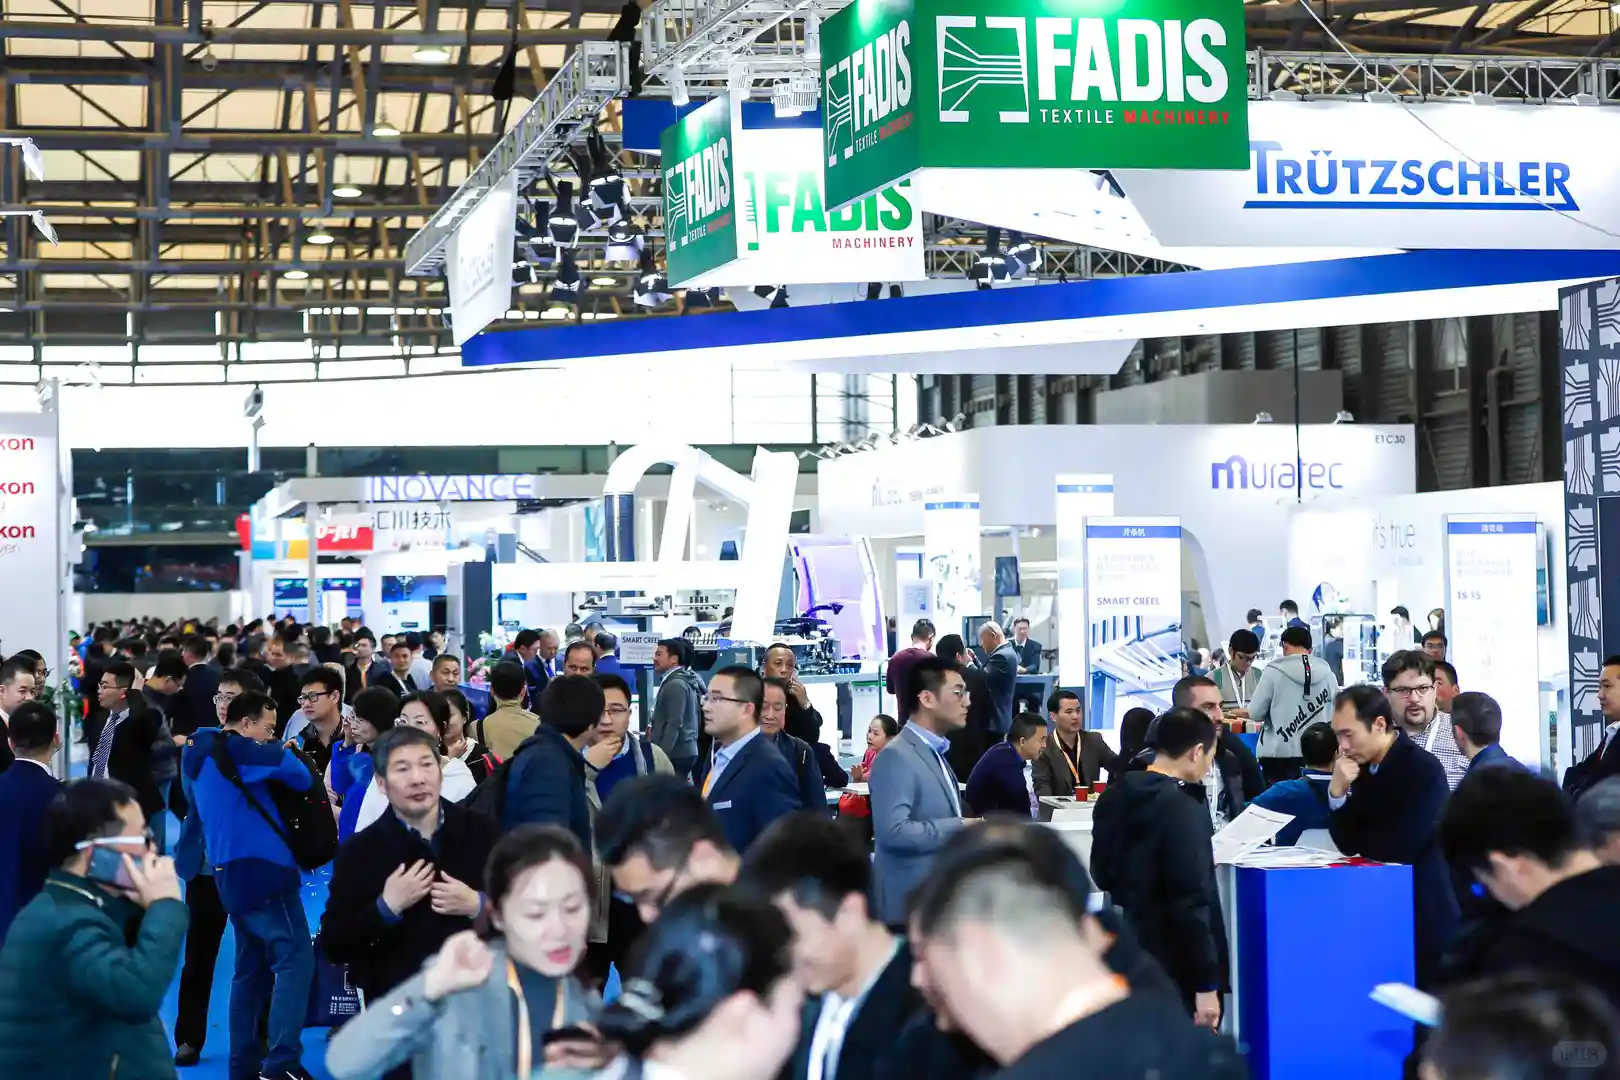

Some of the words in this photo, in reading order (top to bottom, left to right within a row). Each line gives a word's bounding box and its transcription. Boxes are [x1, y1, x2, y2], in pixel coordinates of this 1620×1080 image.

[1035, 17, 1229, 103] FADIS
[852, 20, 912, 132] FADIS
[1040, 109, 1114, 123] TEXTILE
[1124, 110, 1229, 125] MACHINERY
[855, 130, 878, 152] TEXTILE
[685, 137, 731, 225] FADIS
[1249, 140, 1577, 206] TRÜTZSCHLER
[833, 237, 914, 249] MACHINERY
[370, 475, 533, 501] INOVANCE
[1097, 597, 1130, 606] SMART
[1133, 597, 1160, 606] CREEL
[622, 636, 643, 645] SMART
